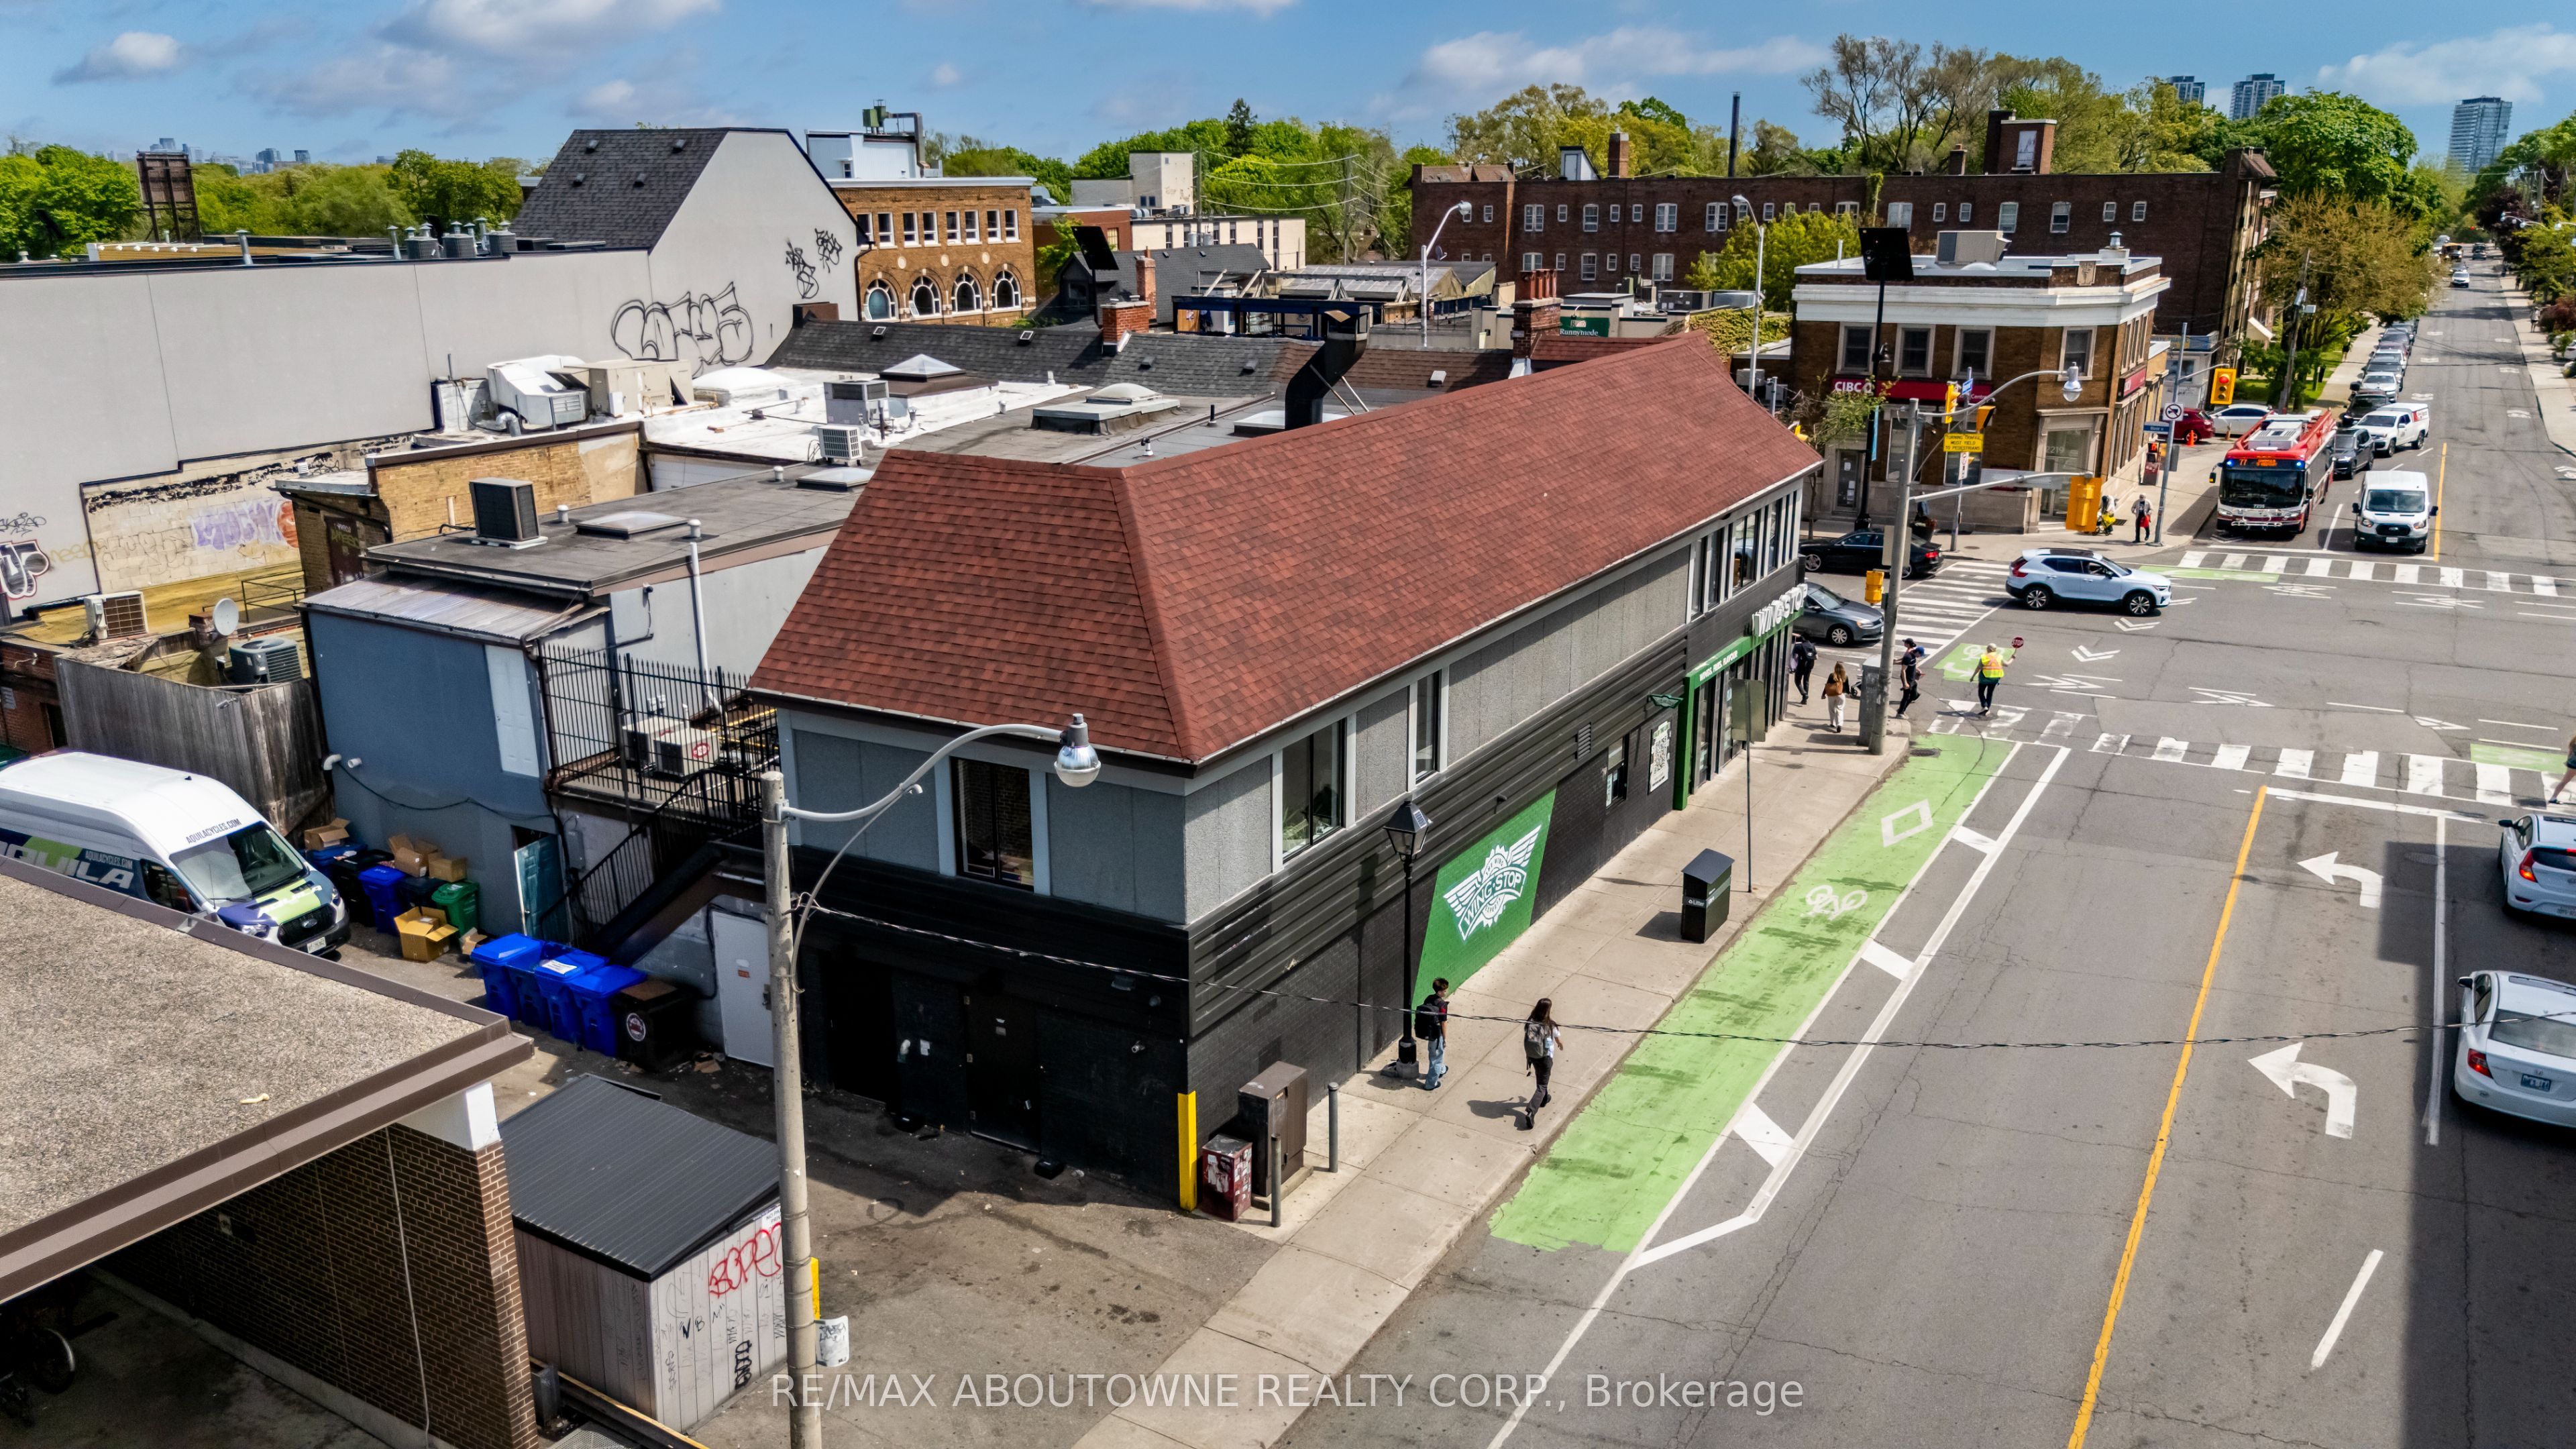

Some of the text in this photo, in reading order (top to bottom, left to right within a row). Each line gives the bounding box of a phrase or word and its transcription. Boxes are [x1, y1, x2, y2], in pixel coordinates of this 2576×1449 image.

[1835, 382, 1862, 392] CIBC
[2046, 445, 2065, 454] 2219
[1752, 584, 1808, 637] WINGSTOP
[186, 818, 242, 845] AQUILACYCLES.COM
[85, 849, 133, 870] AQUILACYCLES.COM
